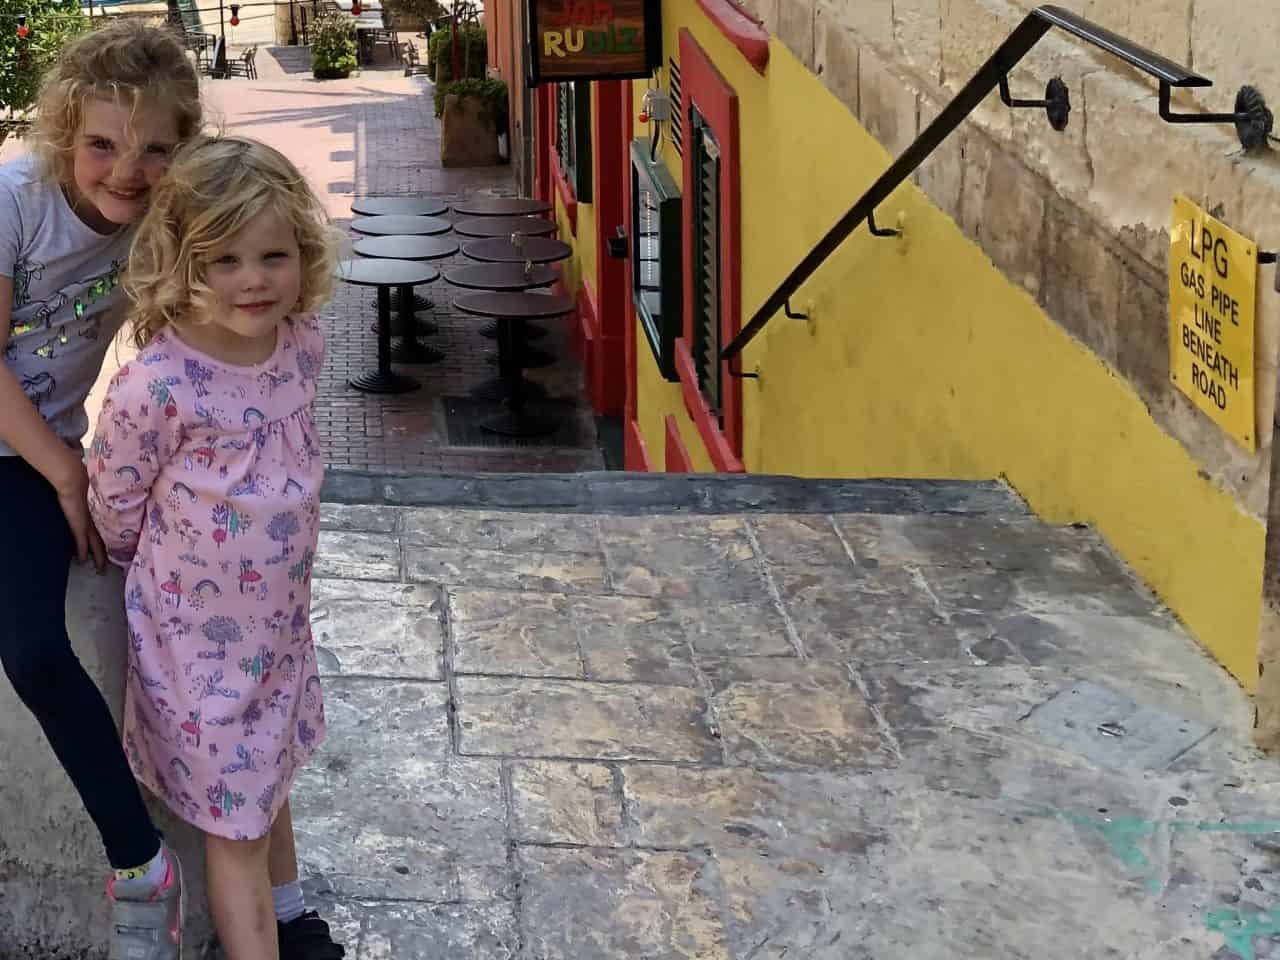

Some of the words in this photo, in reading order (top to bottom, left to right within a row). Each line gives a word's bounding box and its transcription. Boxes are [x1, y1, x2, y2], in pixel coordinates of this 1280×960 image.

[1190, 218, 1228, 280] LPG
[1180, 261, 1205, 300] GAS
[1211, 285, 1239, 327] PIPE
[1193, 303, 1222, 345] LINE
[1182, 323, 1239, 391] BENEATH
[1192, 363, 1227, 411] ROAD
